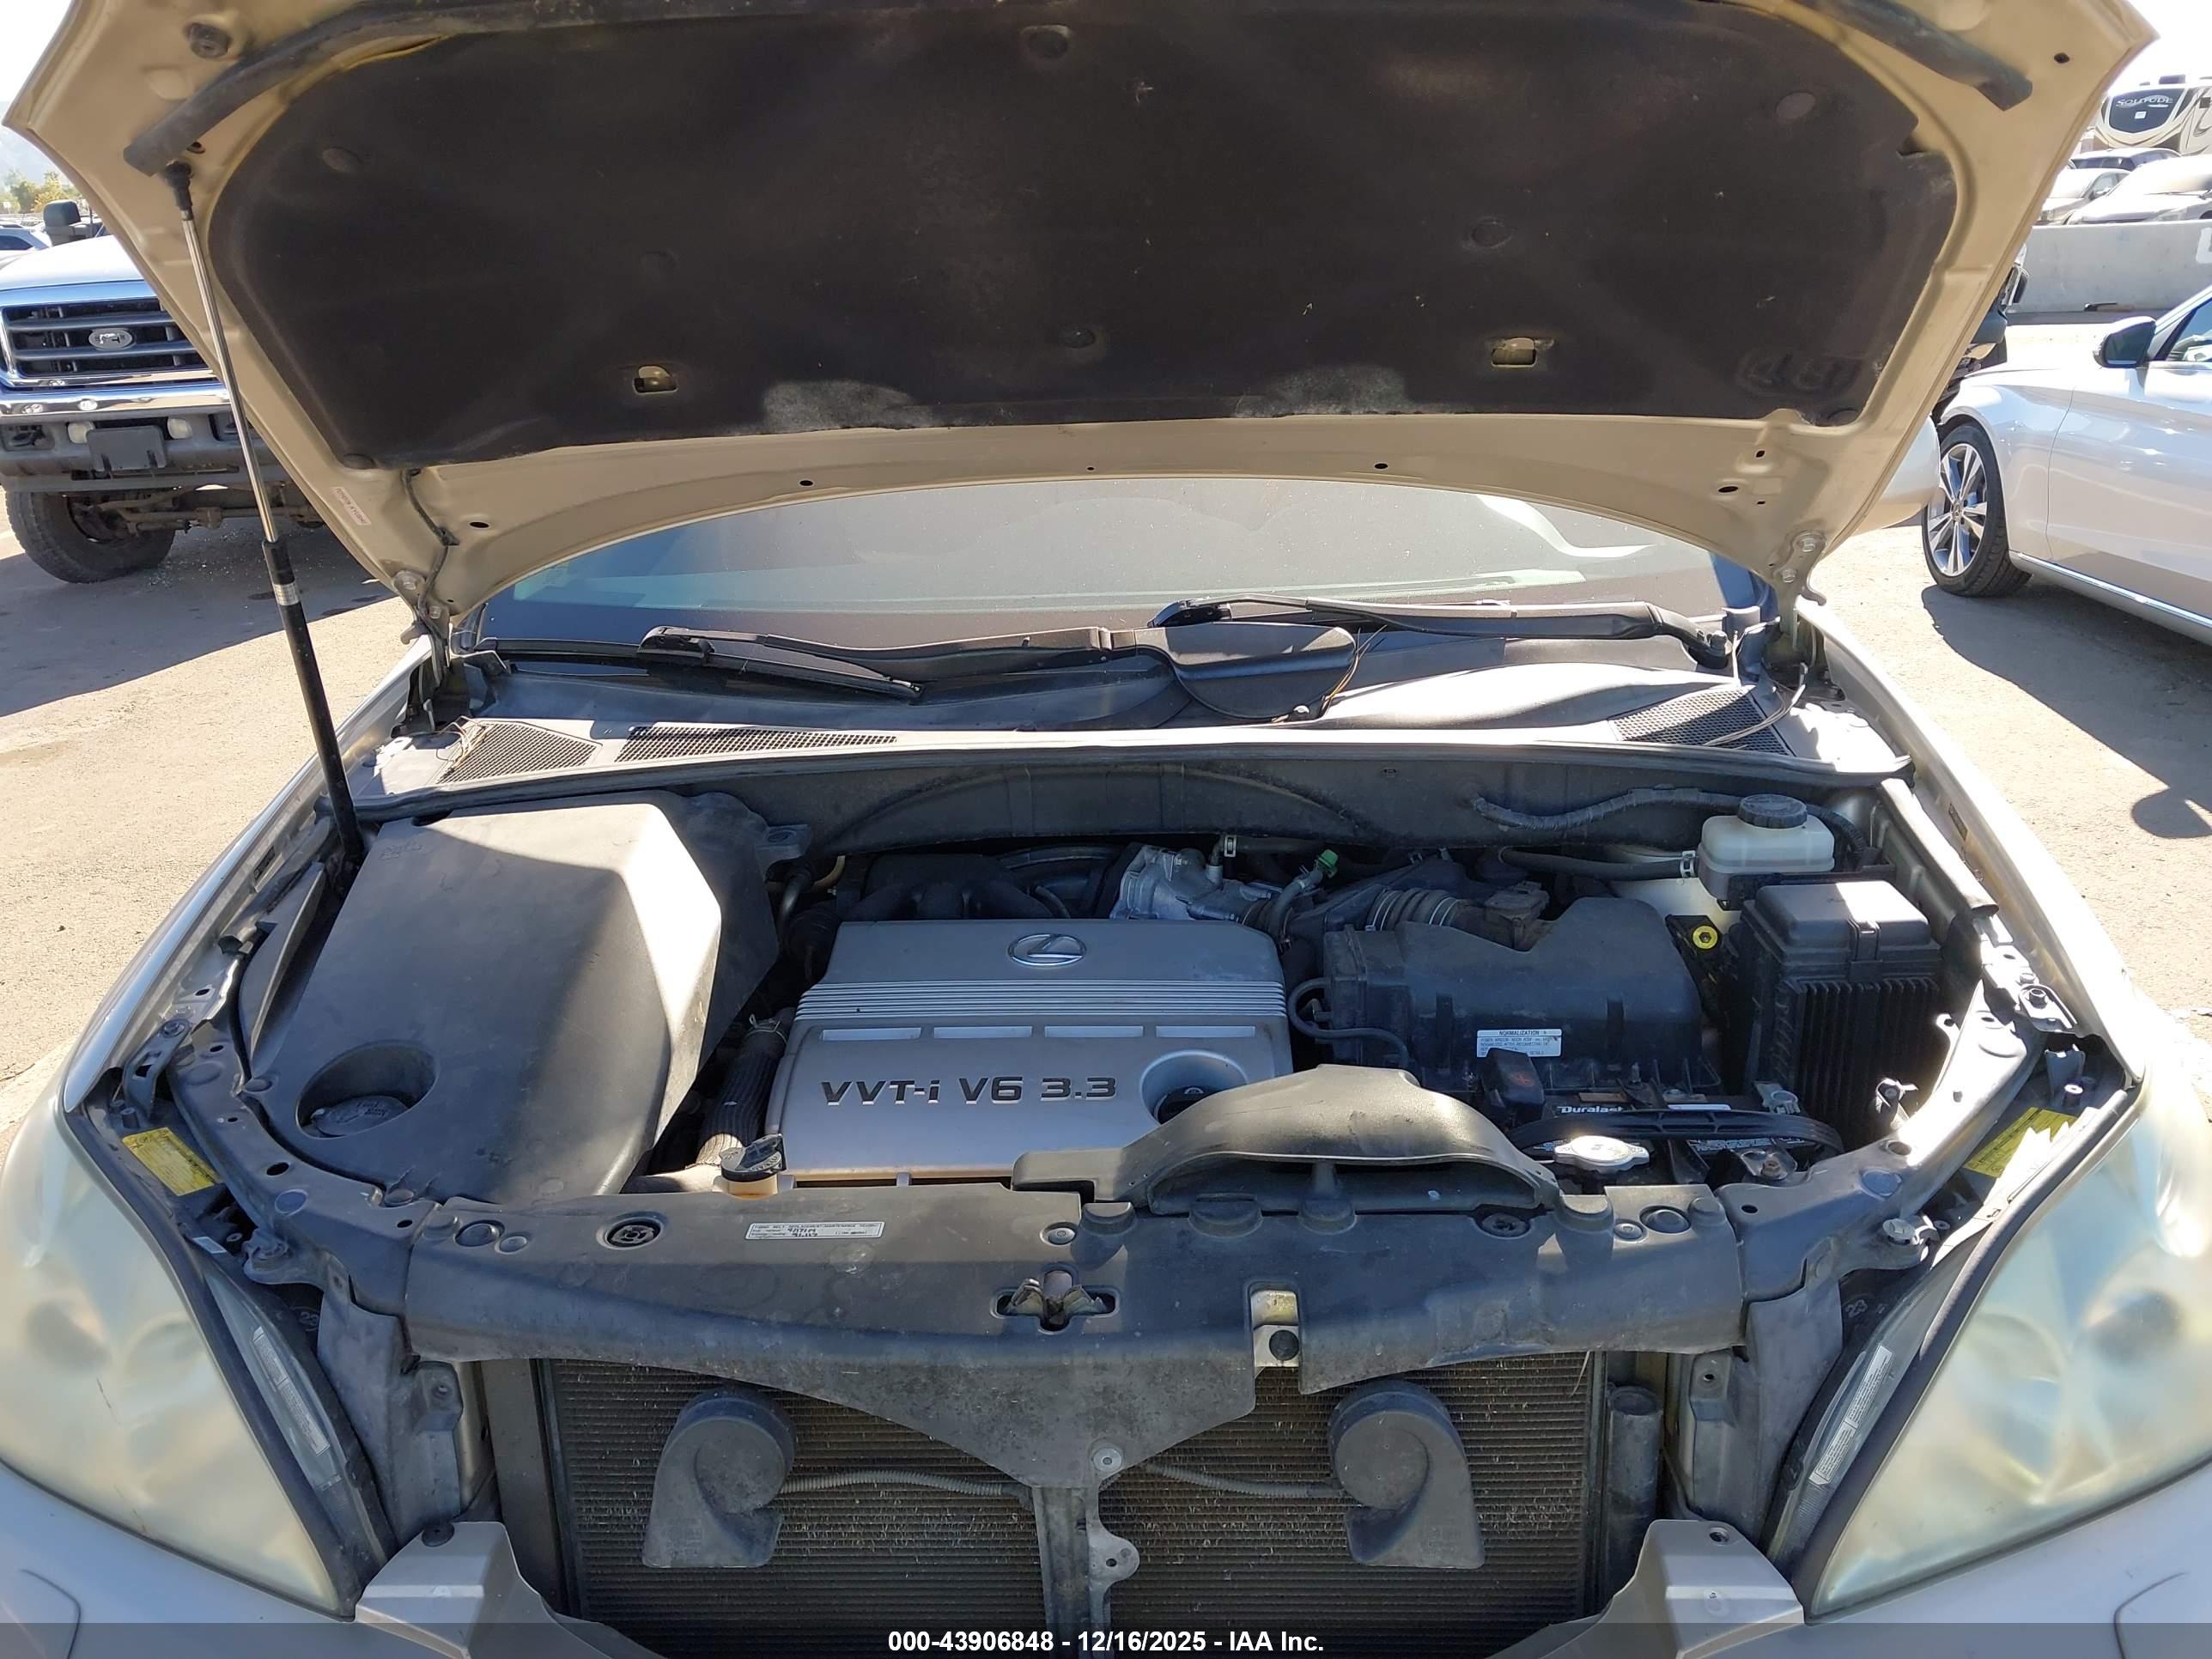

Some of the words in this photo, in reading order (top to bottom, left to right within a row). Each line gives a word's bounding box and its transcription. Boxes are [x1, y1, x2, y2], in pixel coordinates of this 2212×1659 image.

[821, 1079, 941, 1106] VVT-i
[958, 1075, 1024, 1104] V6
[1040, 1076, 1117, 1102] 3.3
